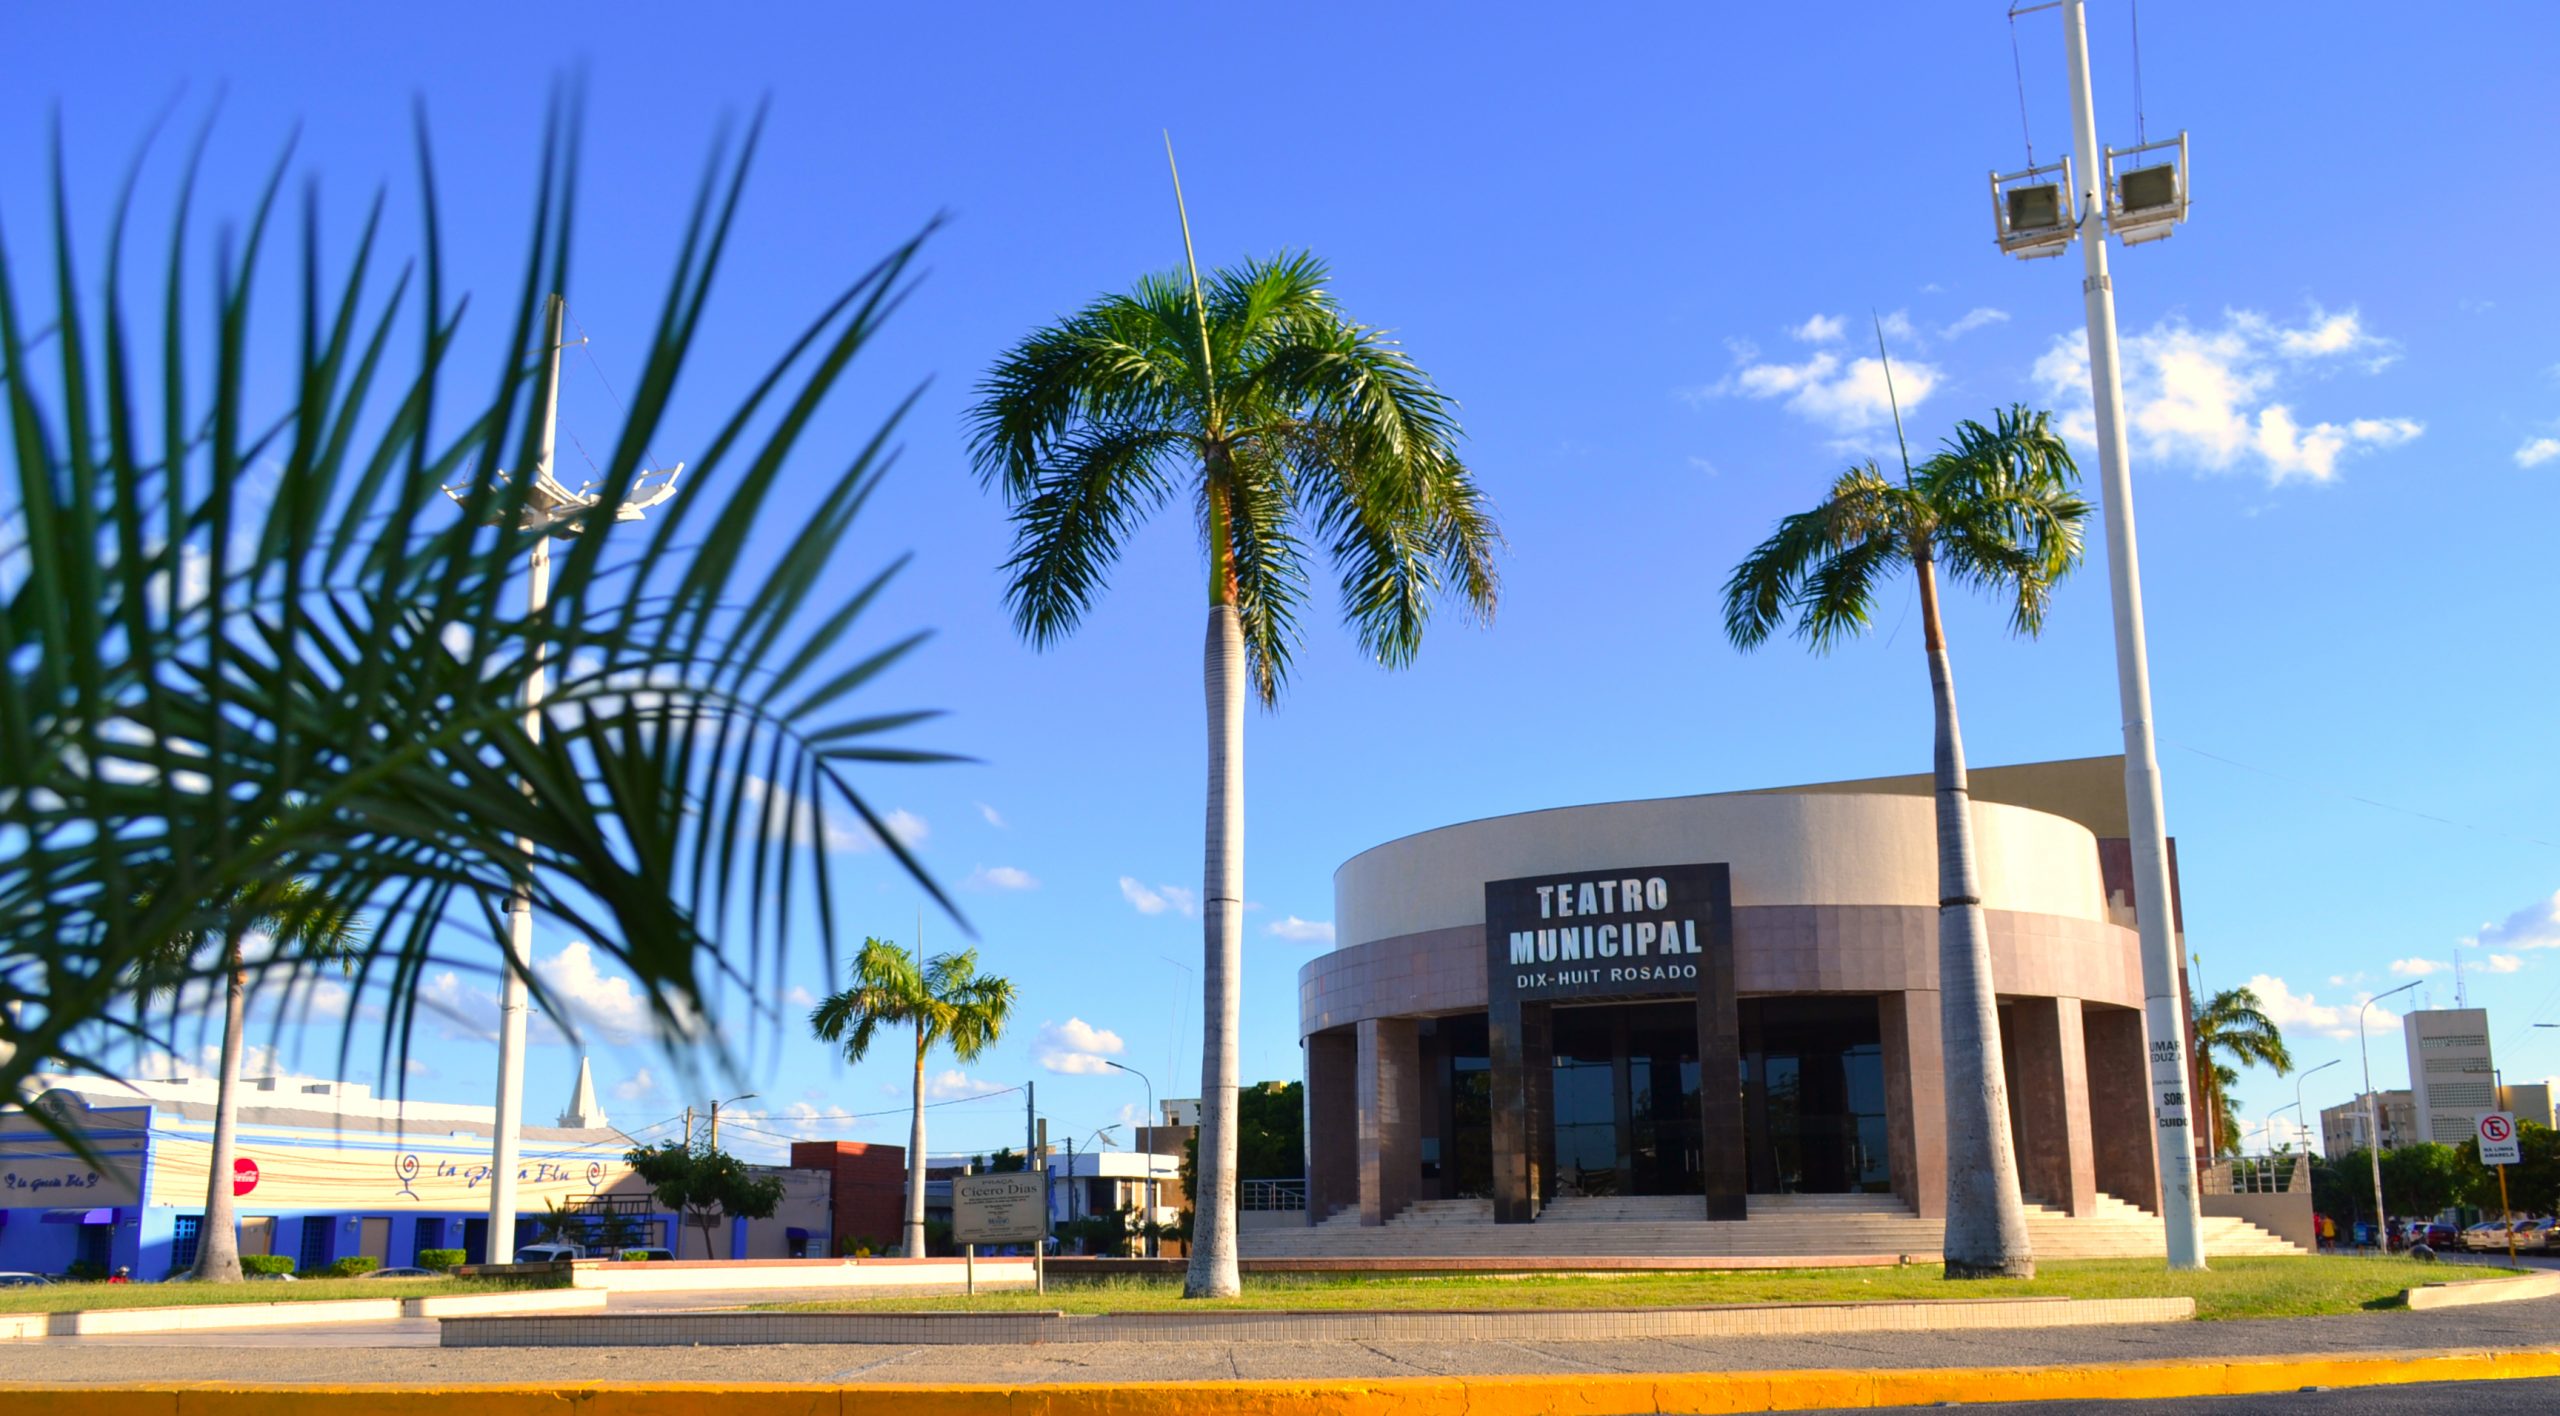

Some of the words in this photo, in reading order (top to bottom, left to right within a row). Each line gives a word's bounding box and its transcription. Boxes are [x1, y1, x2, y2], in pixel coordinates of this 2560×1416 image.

[1536, 877, 1668, 919] TEATRO
[1510, 920, 1702, 965] MUNICIPAL
[1517, 969, 1601, 988] DIX-HUIT
[1611, 965, 1697, 981] ROSADO
